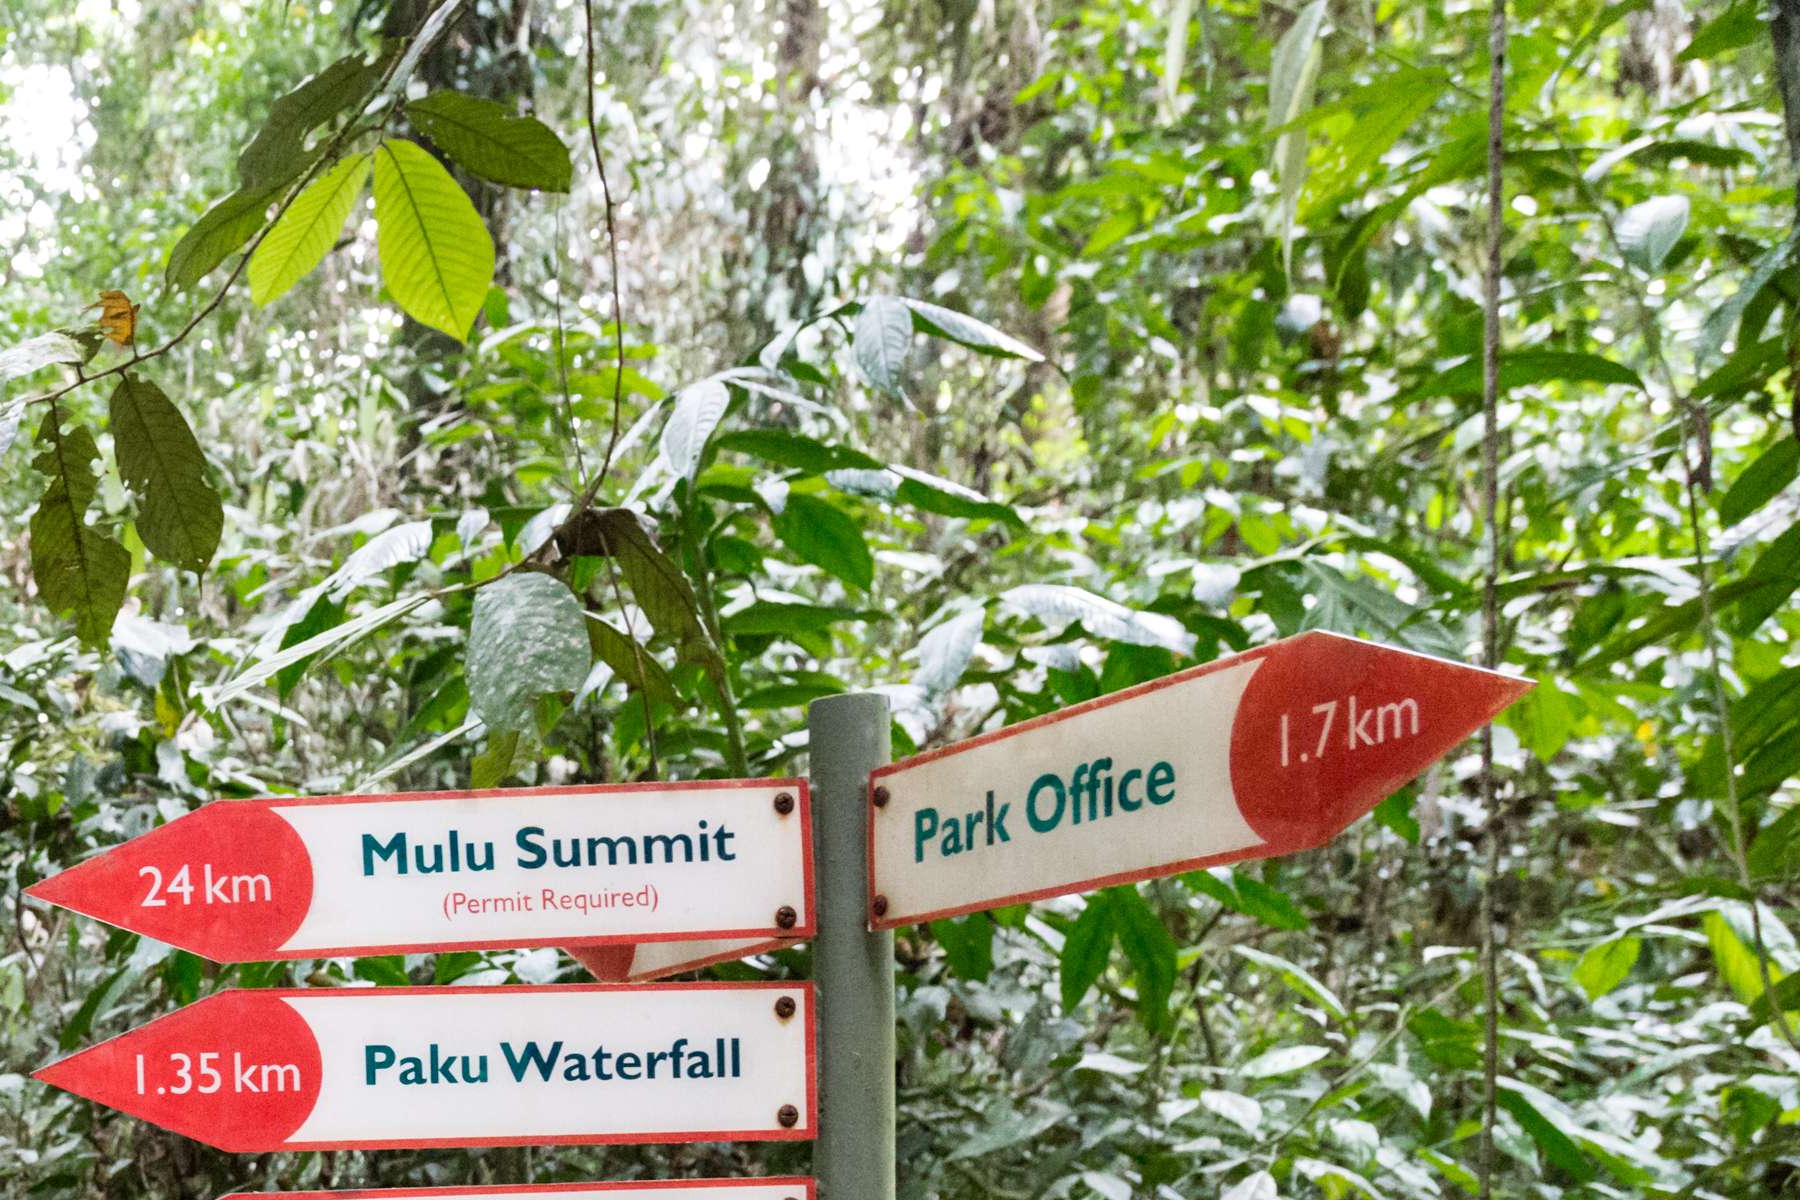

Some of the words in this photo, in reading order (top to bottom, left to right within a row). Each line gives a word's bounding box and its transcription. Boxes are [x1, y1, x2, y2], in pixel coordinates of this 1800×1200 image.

[1279, 700, 1338, 768] 1.7
[1348, 695, 1419, 750] km
[914, 791, 1011, 864] Park
[1025, 756, 1176, 834] Office
[361, 829, 495, 877] Mulu
[515, 819, 737, 870] Summit
[138, 863, 195, 908] 24
[203, 863, 272, 905] km
[443, 891, 533, 921] (Permit
[541, 884, 659, 916] Required)
[136, 1052, 222, 1095] 1.35
[233, 1051, 301, 1093] km
[364, 1043, 489, 1086] Paku
[499, 1037, 741, 1083] Waterfall
